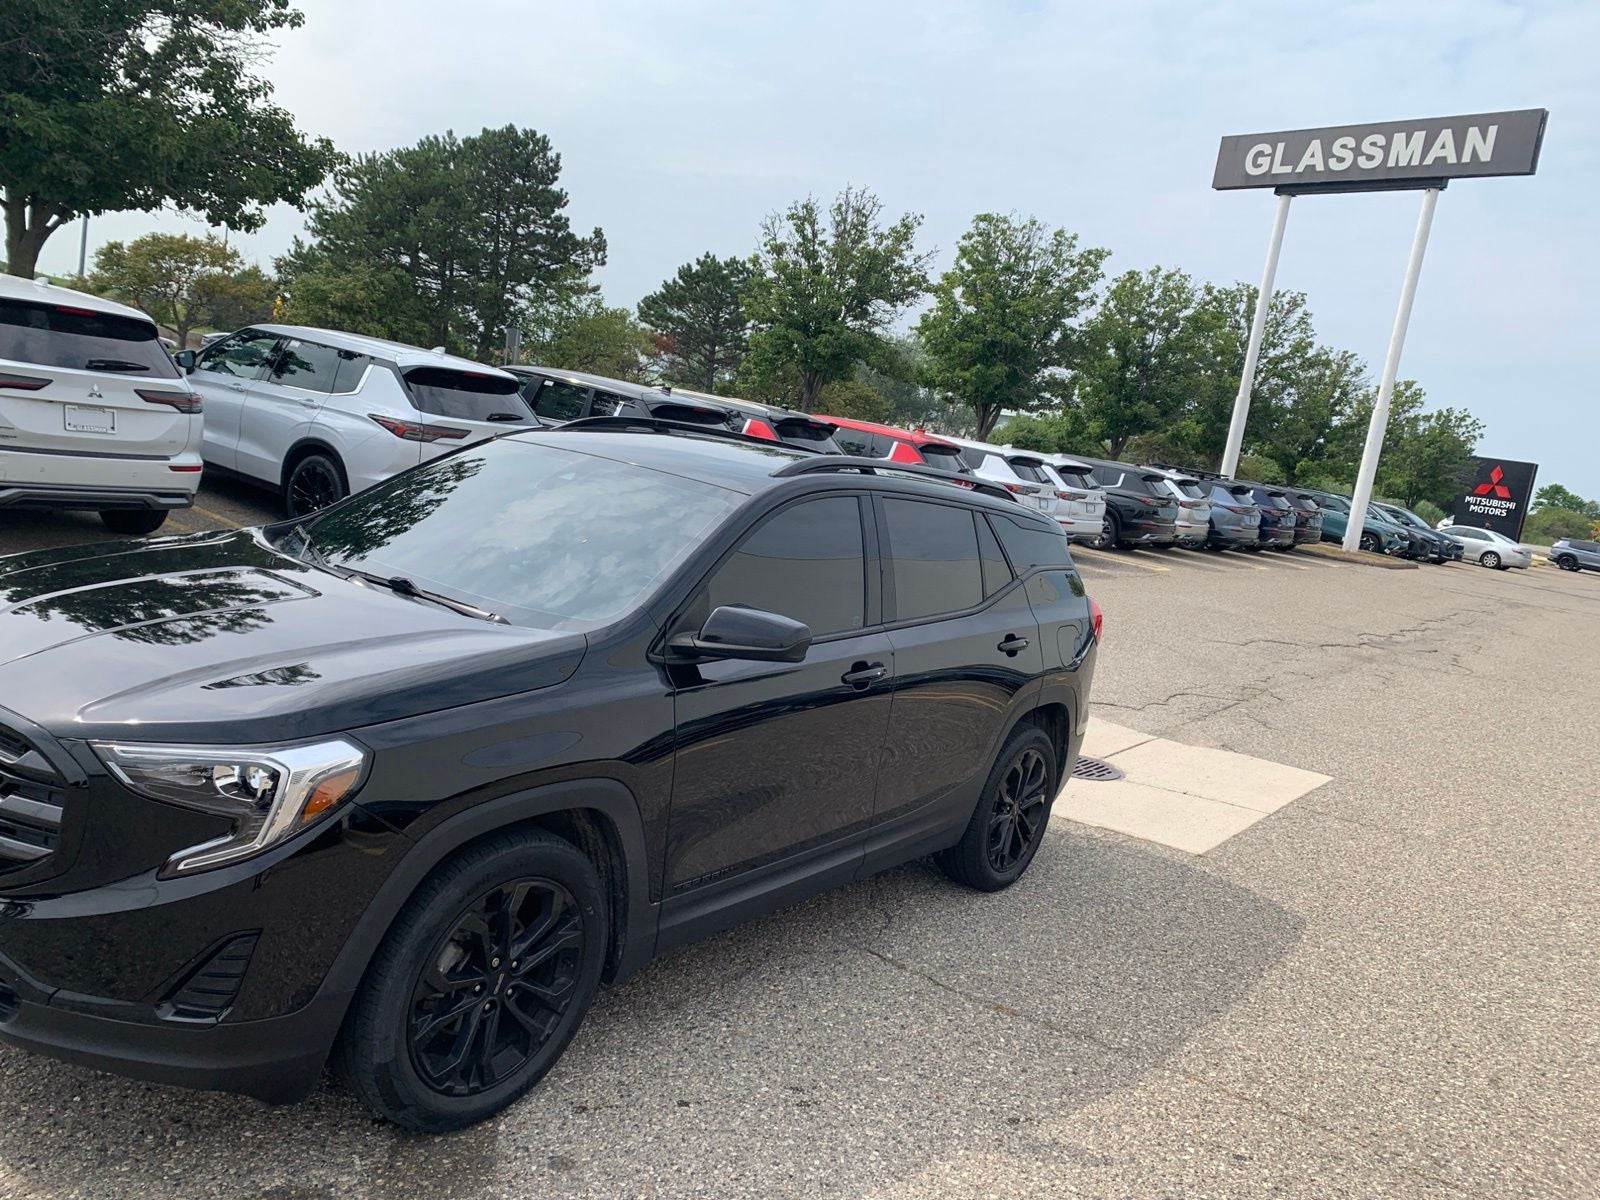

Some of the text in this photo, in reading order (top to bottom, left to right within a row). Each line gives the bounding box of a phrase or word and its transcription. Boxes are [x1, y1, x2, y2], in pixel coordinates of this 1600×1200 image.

[1245, 125, 1498, 176] GLASSMAN
[1465, 496, 1516, 510] MITSUBISHI
[1469, 505, 1507, 517] MOTORS
